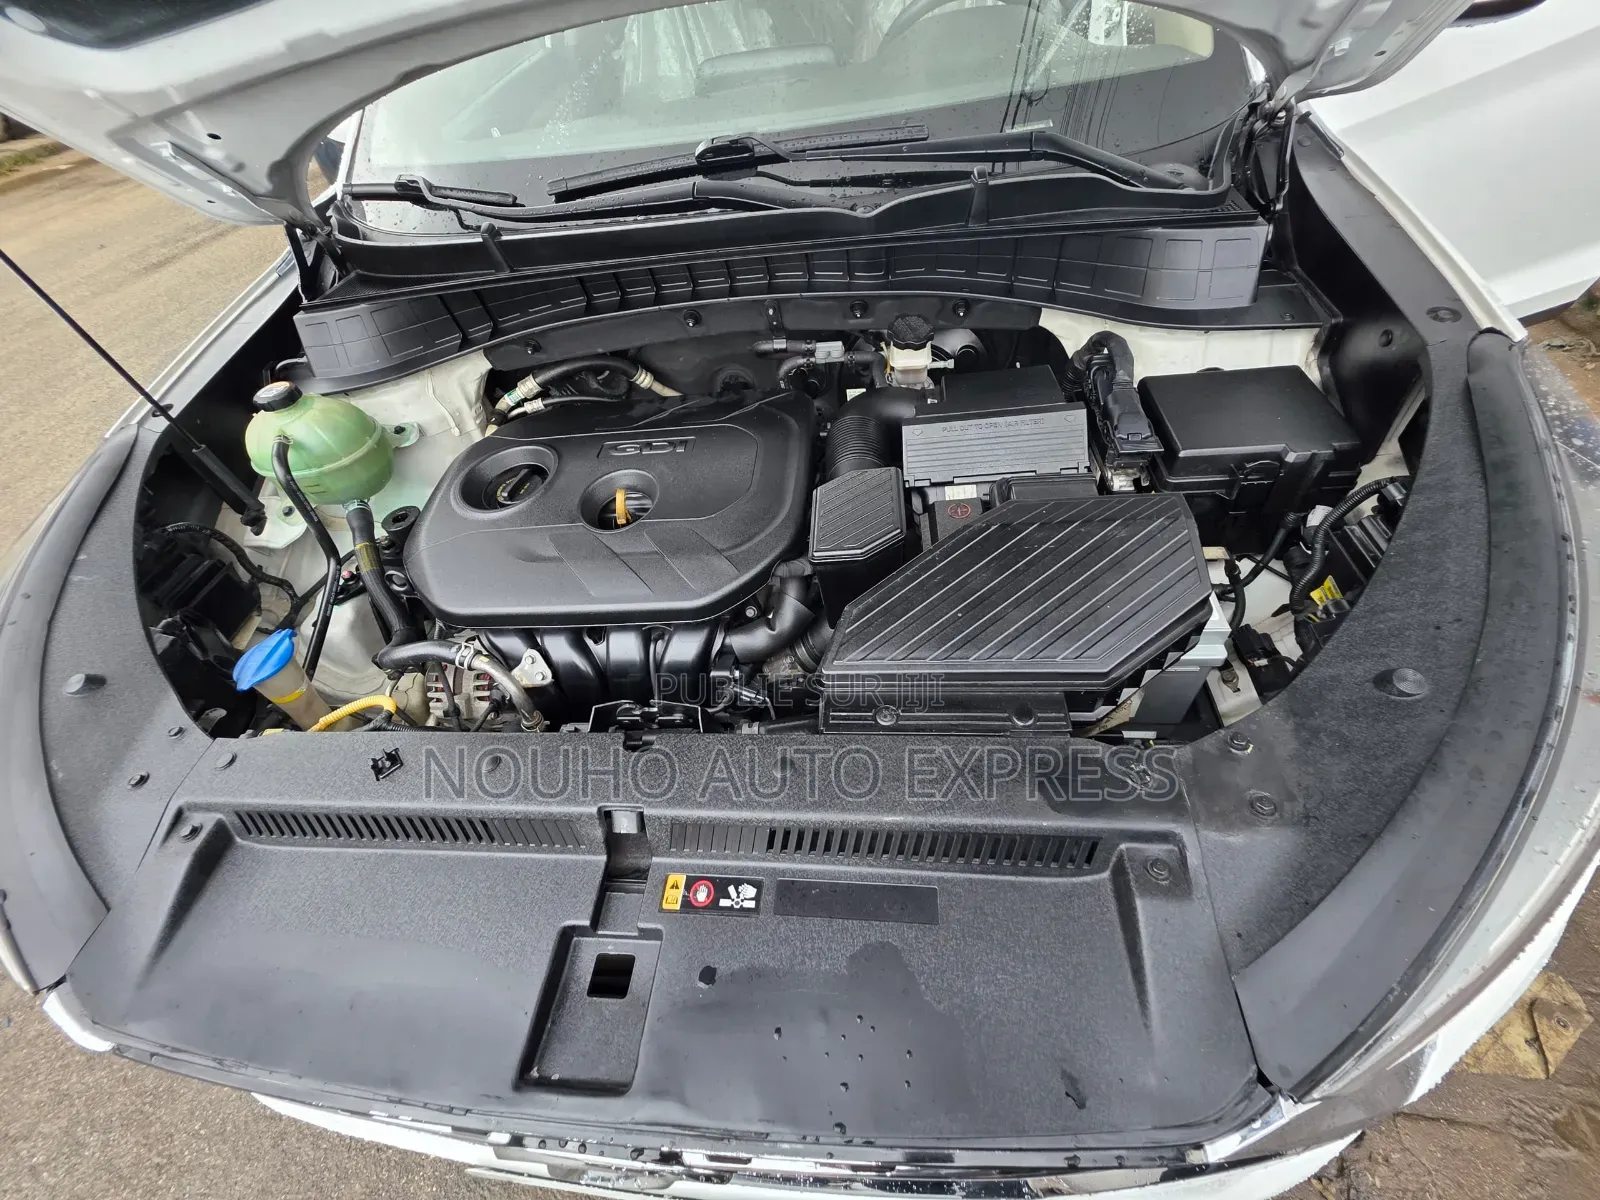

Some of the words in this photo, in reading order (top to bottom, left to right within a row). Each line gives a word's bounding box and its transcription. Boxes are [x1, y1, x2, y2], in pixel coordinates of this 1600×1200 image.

[942, 425, 959, 433] PULL
[960, 423, 973, 432] OUT
[608, 440, 689, 456] GDI
